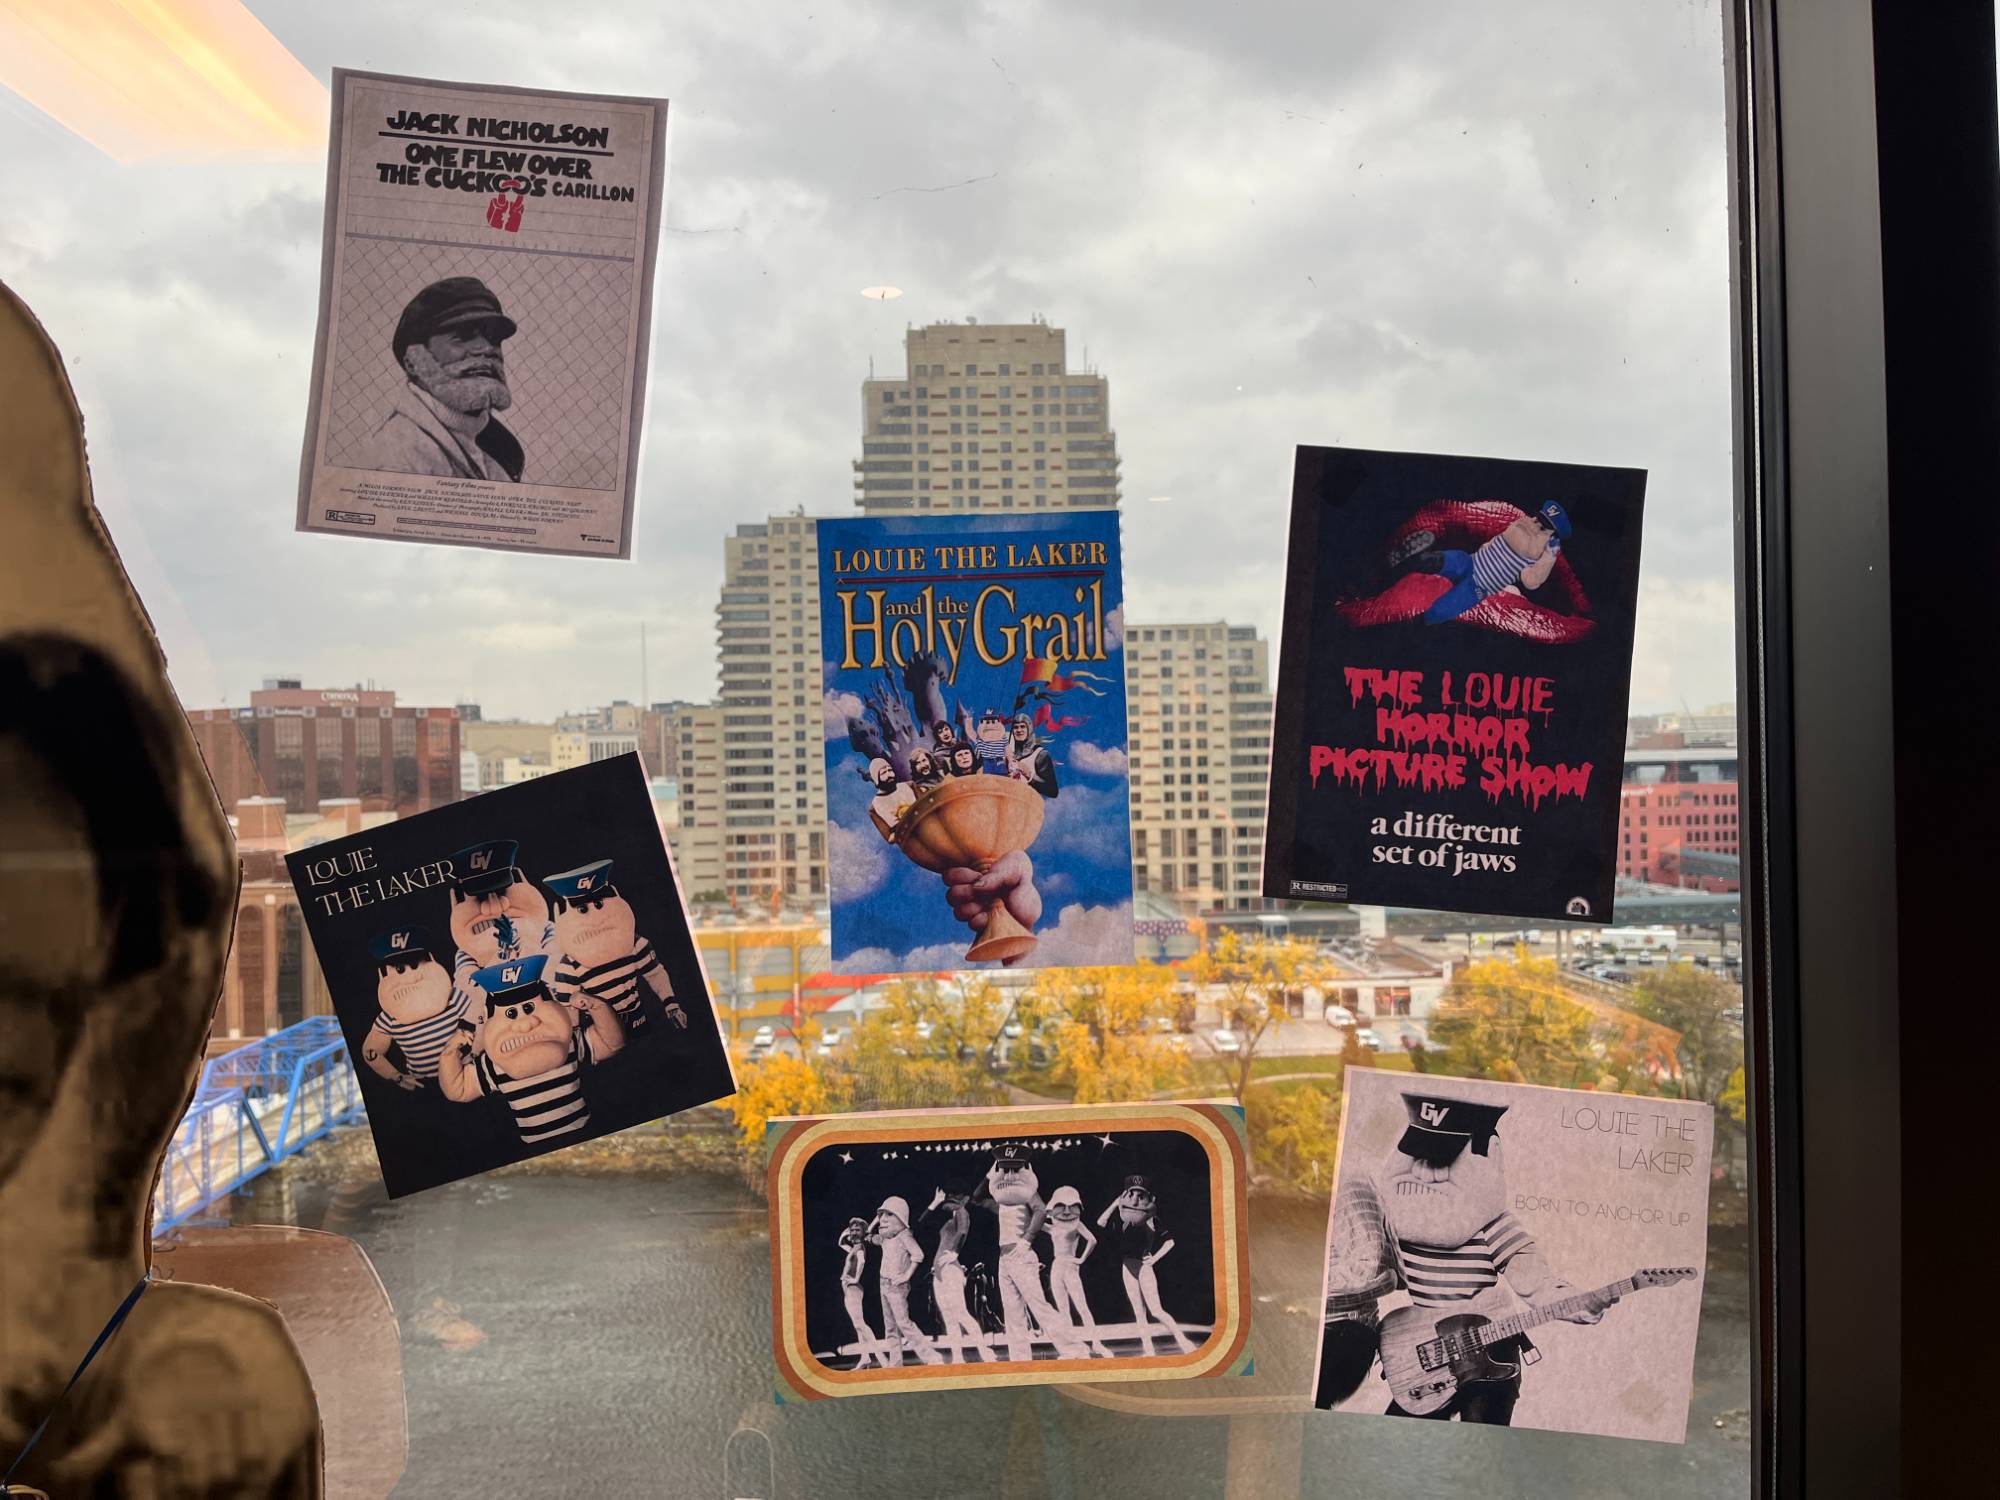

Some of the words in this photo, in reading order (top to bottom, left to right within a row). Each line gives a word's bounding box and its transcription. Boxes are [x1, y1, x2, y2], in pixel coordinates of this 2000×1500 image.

[386, 110, 460, 135] JACK
[466, 117, 609, 148] NICHOLSON
[405, 143, 460, 168] ONE
[462, 148, 526, 173] FLEW
[528, 153, 592, 179] OVER
[376, 163, 420, 186] THE
[424, 167, 548, 197] CUCKOO'S
[552, 177, 635, 202] CARILLON
[833, 547, 925, 573] LOUIE
[935, 545, 997, 570] THE
[1006, 541, 1108, 568] LAKER
[886, 600, 922, 616] and
[937, 596, 968, 614] the
[836, 584, 968, 686] Holy
[973, 578, 1108, 667] Grail
[1344, 667, 1424, 711] THE
[1441, 671, 1555, 724] LOUIE
[1376, 707, 1530, 758] HORROR
[1309, 745, 1467, 796] PICTURE
[1480, 755, 1594, 811] SHOW
[1370, 816, 1388, 836] a
[1393, 811, 1522, 845] different
[305, 847, 378, 885] LOUIE
[469, 849, 494, 871] GV
[1372, 844, 1413, 864] set
[1418, 842, 1453, 867] of
[1453, 845, 1517, 876] jaws
[315, 883, 375, 916] THE
[380, 860, 458, 901] LAKER
[576, 874, 599, 891] GV
[390, 931, 410, 950] GV
[501, 964, 525, 984] GV
[1420, 1103, 1449, 1126] GV
[1560, 1106, 1640, 1136] LOUIE
[1650, 1114, 1696, 1142] THE
[1618, 1146, 1694, 1176] LAKER
[1515, 1195, 1560, 1213] BORN
[1565, 1199, 1589, 1217] TO
[1595, 1203, 1664, 1225] ANCHOR
[1669, 1210, 1691, 1226] UP
